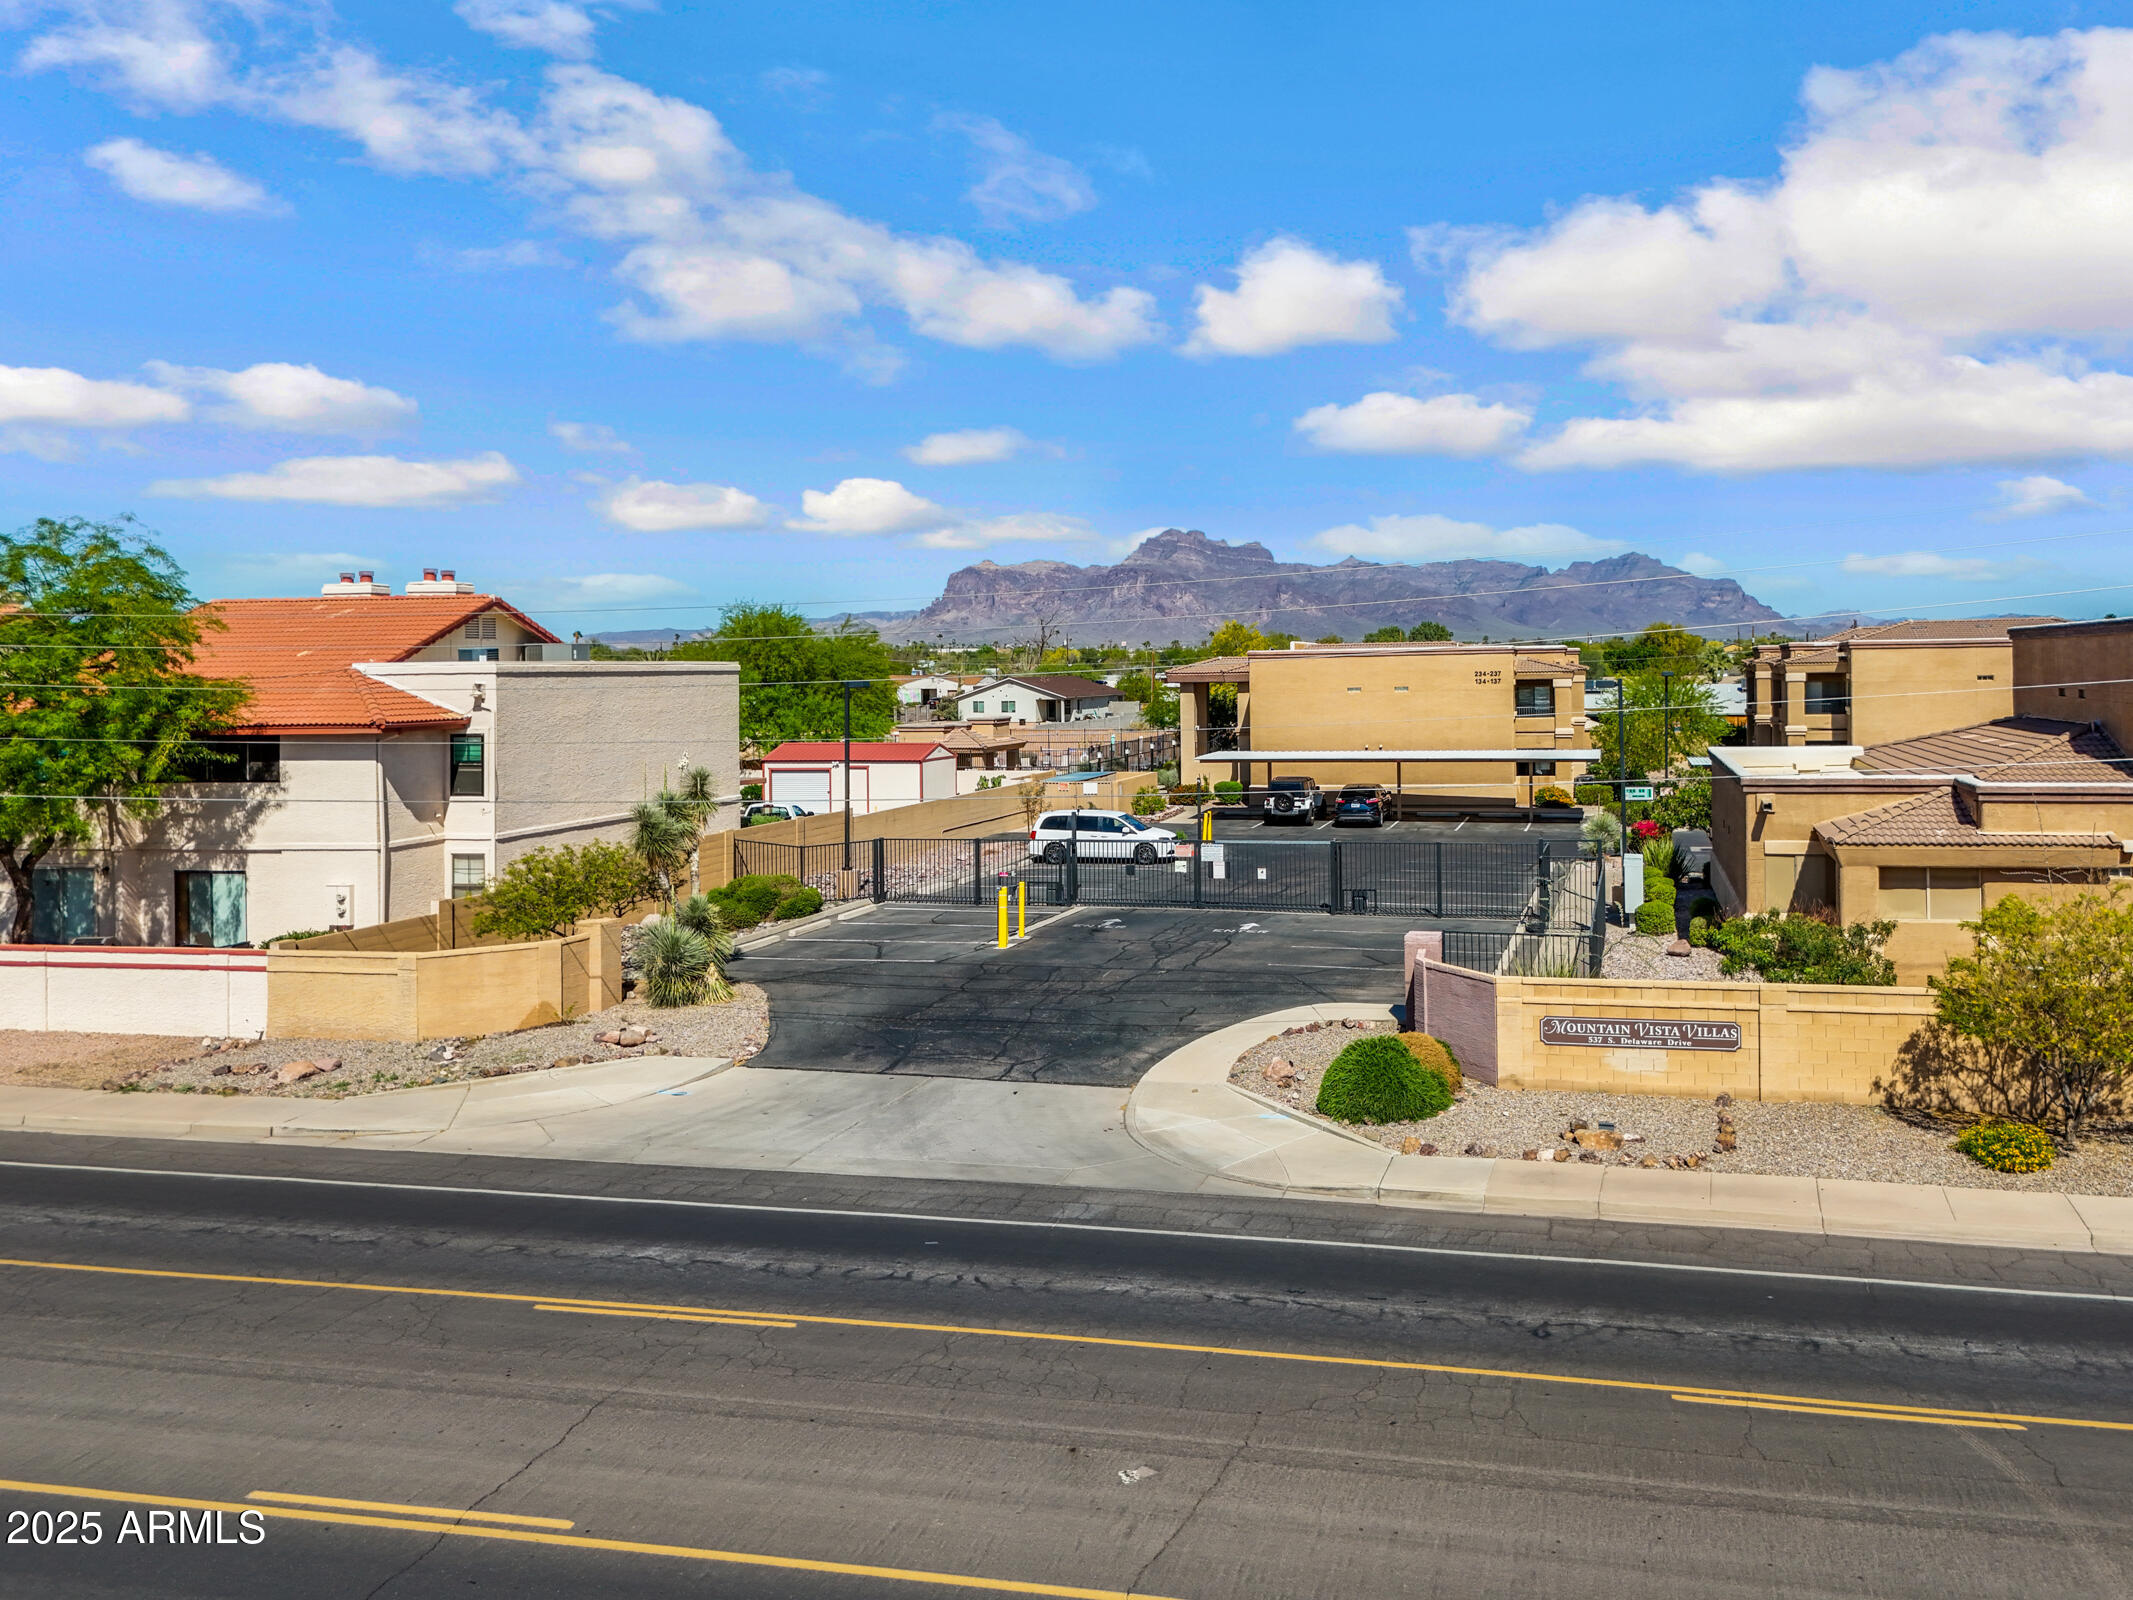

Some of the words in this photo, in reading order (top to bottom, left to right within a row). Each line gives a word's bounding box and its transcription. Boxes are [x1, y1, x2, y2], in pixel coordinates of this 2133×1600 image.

[1544, 1020, 1630, 1035] MOUNTAIN
[1635, 1022, 1680, 1037] VISTA
[1683, 1024, 1737, 1039] VILLAS
[1588, 1036, 1603, 1044] 537
[1621, 1038, 1662, 1046] Delaware
[1667, 1039, 1692, 1047] Drive
